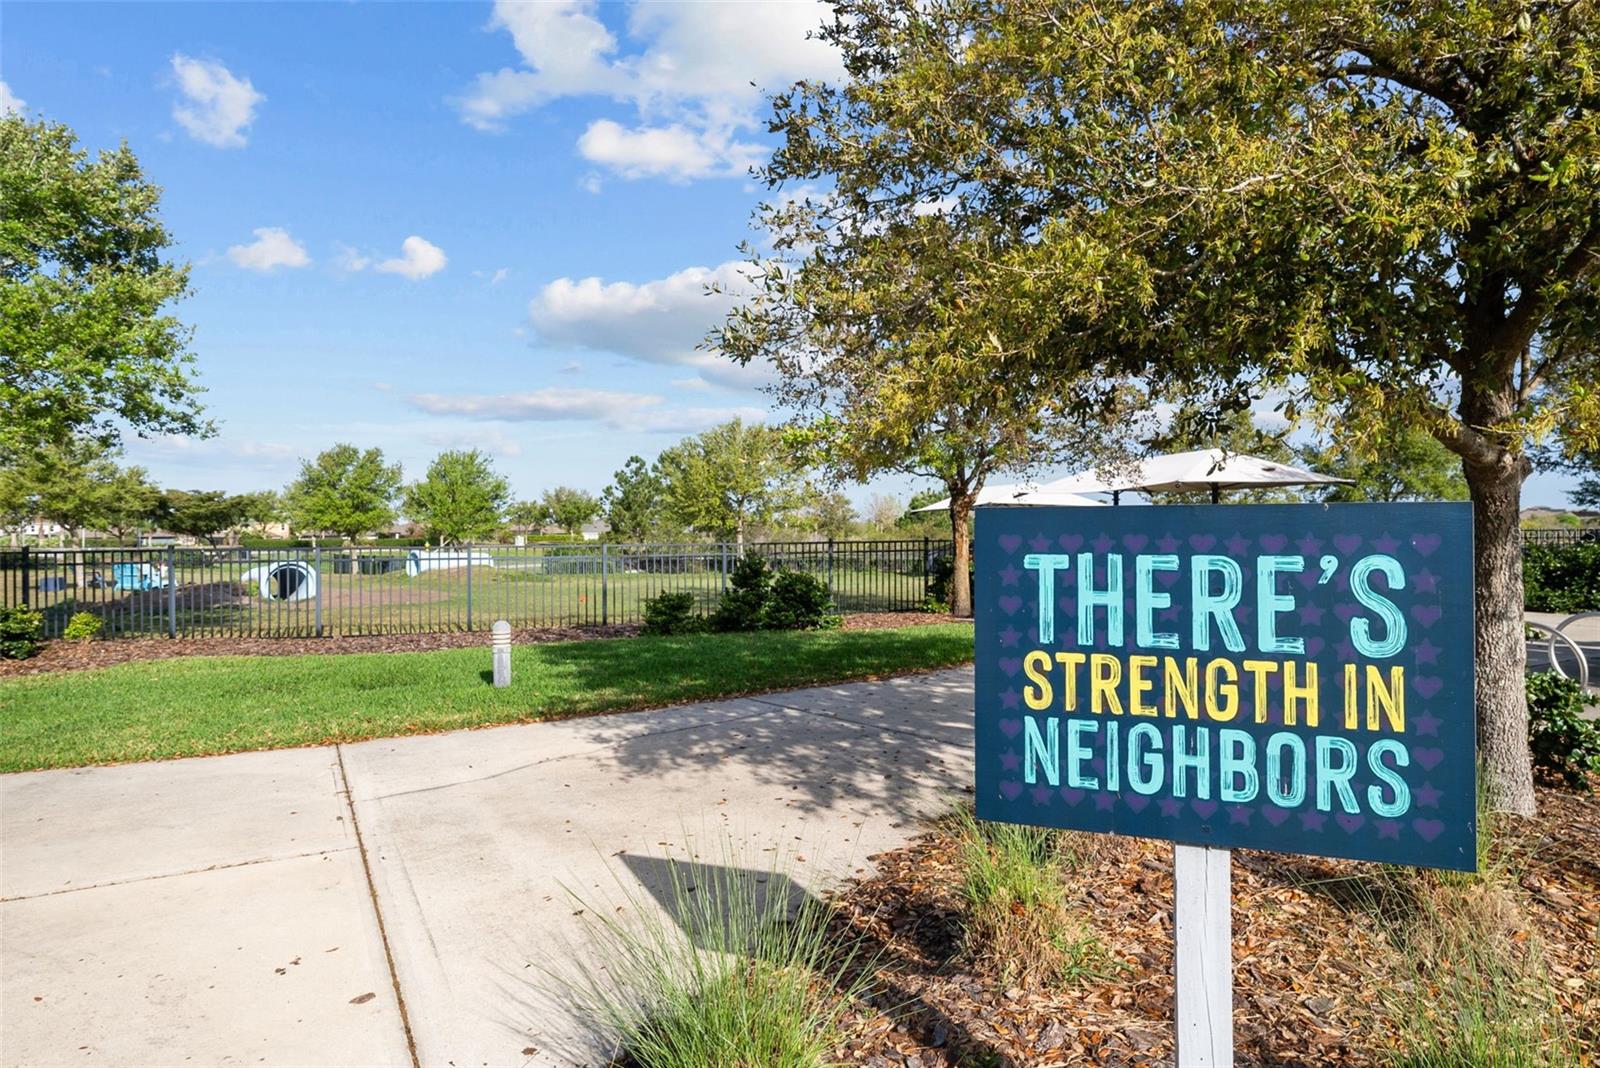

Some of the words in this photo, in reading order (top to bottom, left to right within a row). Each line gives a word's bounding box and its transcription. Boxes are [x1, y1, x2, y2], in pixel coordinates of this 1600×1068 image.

[1023, 553, 1408, 659] THERE'S
[1023, 651, 1319, 727] STRENGTH
[1344, 663, 1405, 733] IN
[1024, 716, 1411, 818] NEIGHBORS
